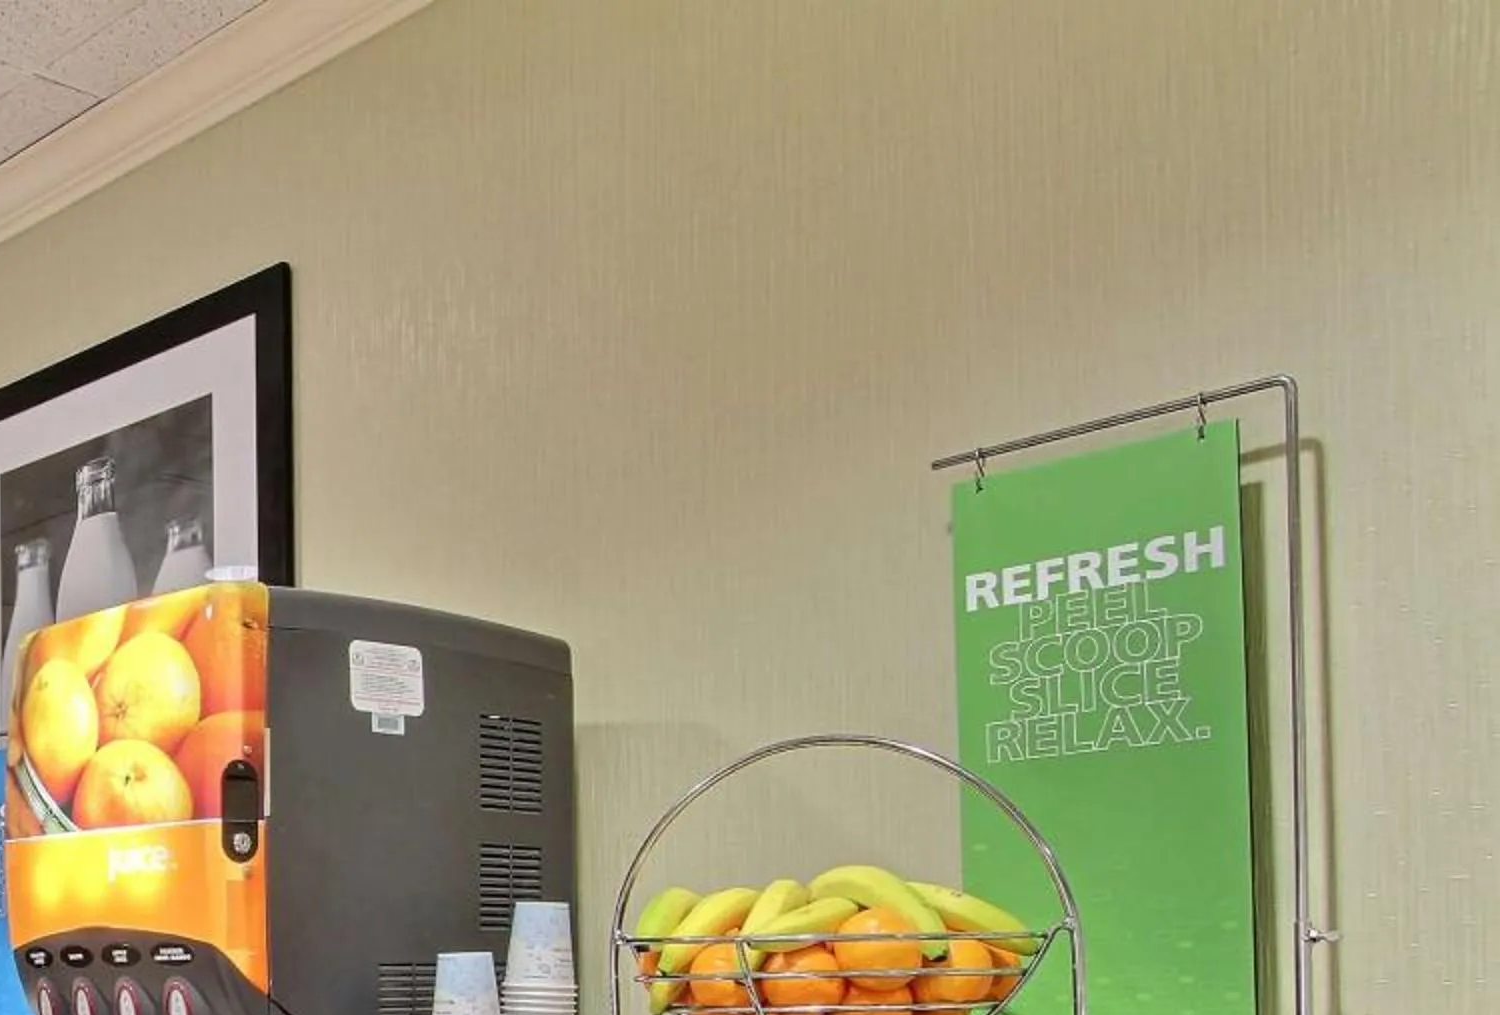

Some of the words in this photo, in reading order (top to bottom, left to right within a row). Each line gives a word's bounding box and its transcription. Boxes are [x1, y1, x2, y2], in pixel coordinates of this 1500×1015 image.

[965, 526, 1225, 612] REFRESH
[1019, 581, 1168, 641] PEEL
[989, 614, 1204, 686] SCOOP
[1009, 658, 1182, 722] SLICE
[986, 697, 1211, 764] RELAX.
